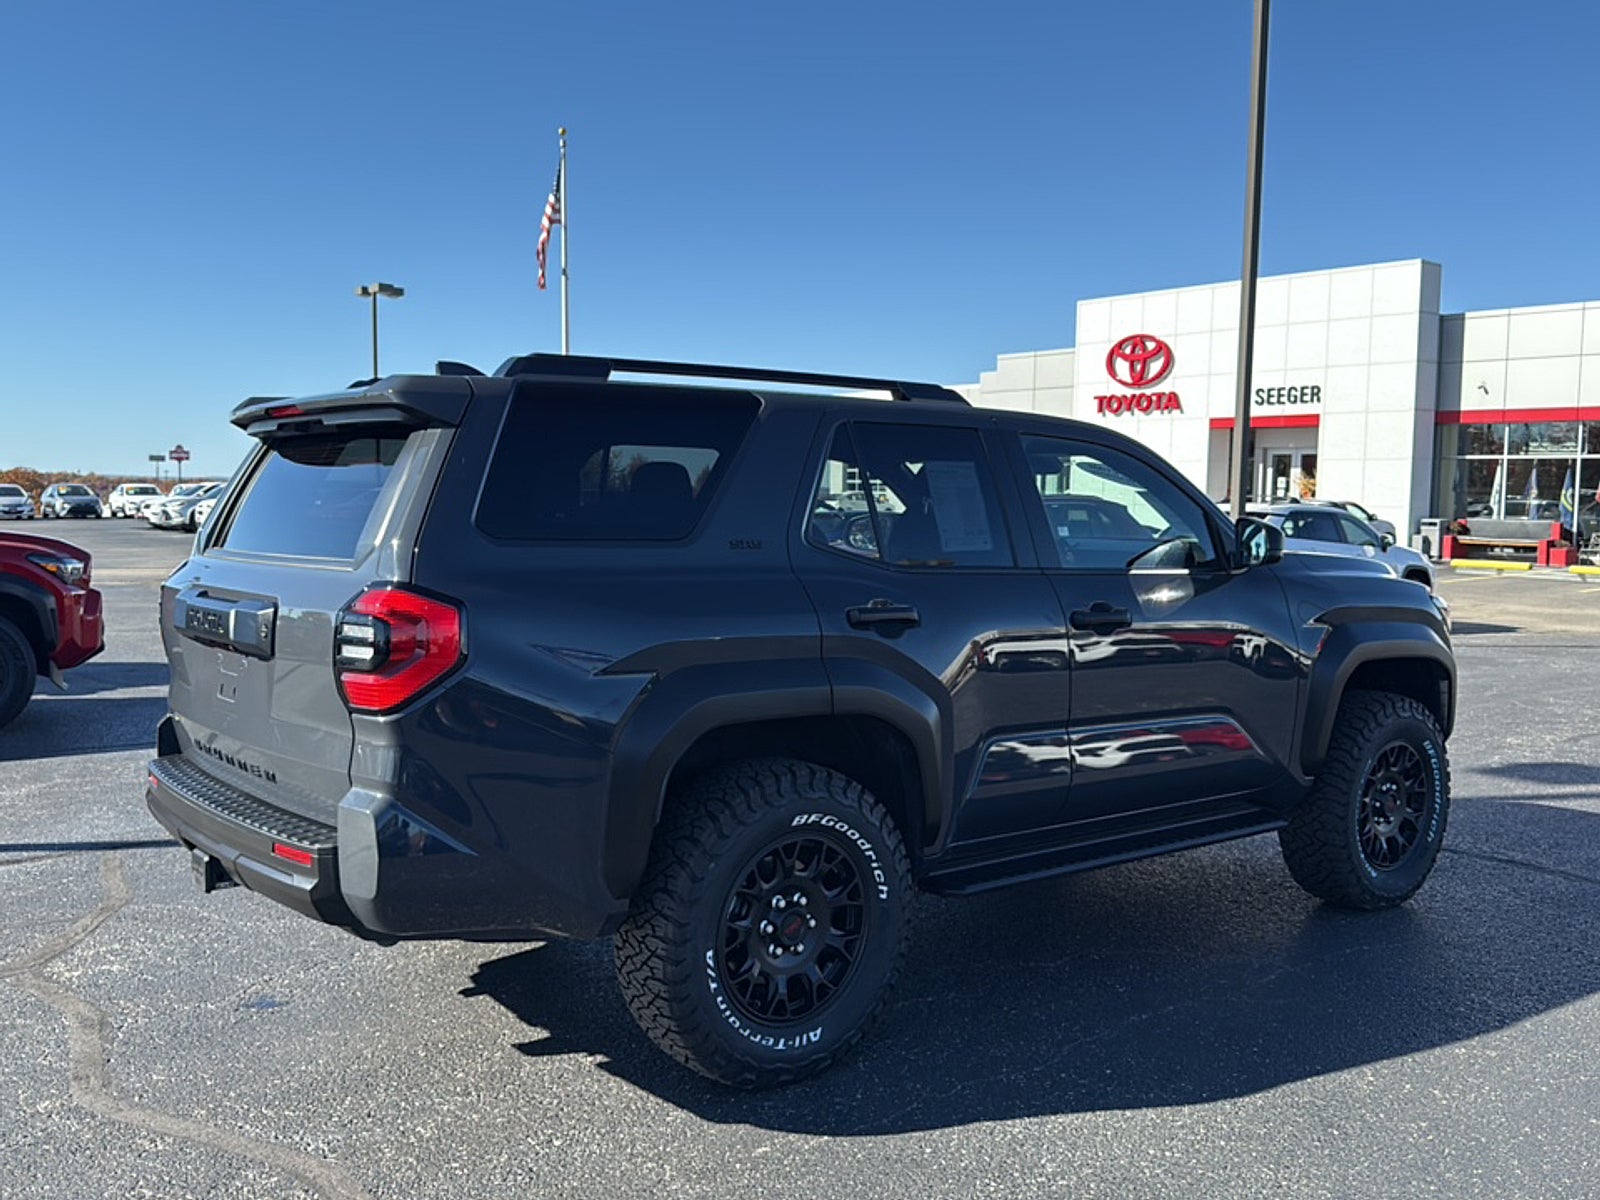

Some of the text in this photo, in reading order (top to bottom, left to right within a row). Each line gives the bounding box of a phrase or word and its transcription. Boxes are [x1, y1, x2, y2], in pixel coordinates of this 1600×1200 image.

[1094, 391, 1183, 414] TOYOTA
[1255, 385, 1322, 406] SEEGER
[791, 813, 889, 900] BFGoodrich
[704, 949, 822, 1050] All-Terrain T/A
